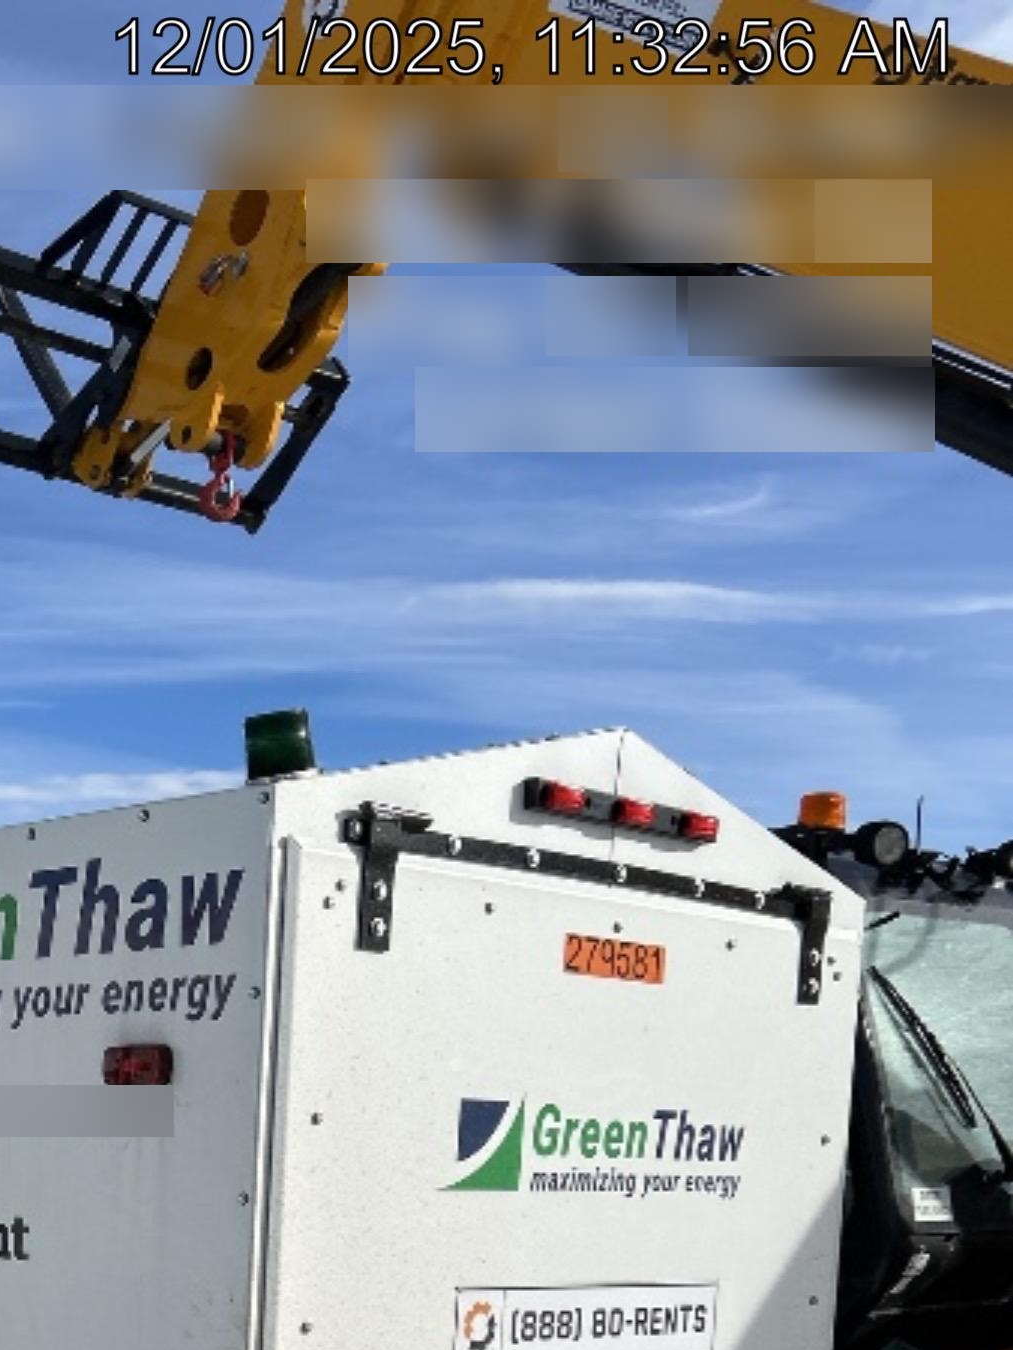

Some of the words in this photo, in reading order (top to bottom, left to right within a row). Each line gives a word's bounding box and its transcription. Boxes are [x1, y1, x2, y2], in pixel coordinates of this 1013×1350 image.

[565, 936, 662, 980] 279581
[10, 978, 91, 1030] your
[101, 970, 238, 1022] energy
[532, 1103, 745, 1162] GreenThaw
[529, 1166, 636, 1196] maximizing
[642, 1172, 679, 1198] your
[685, 1172, 741, 1200] energy
[511, 1307, 582, 1344] (888)
